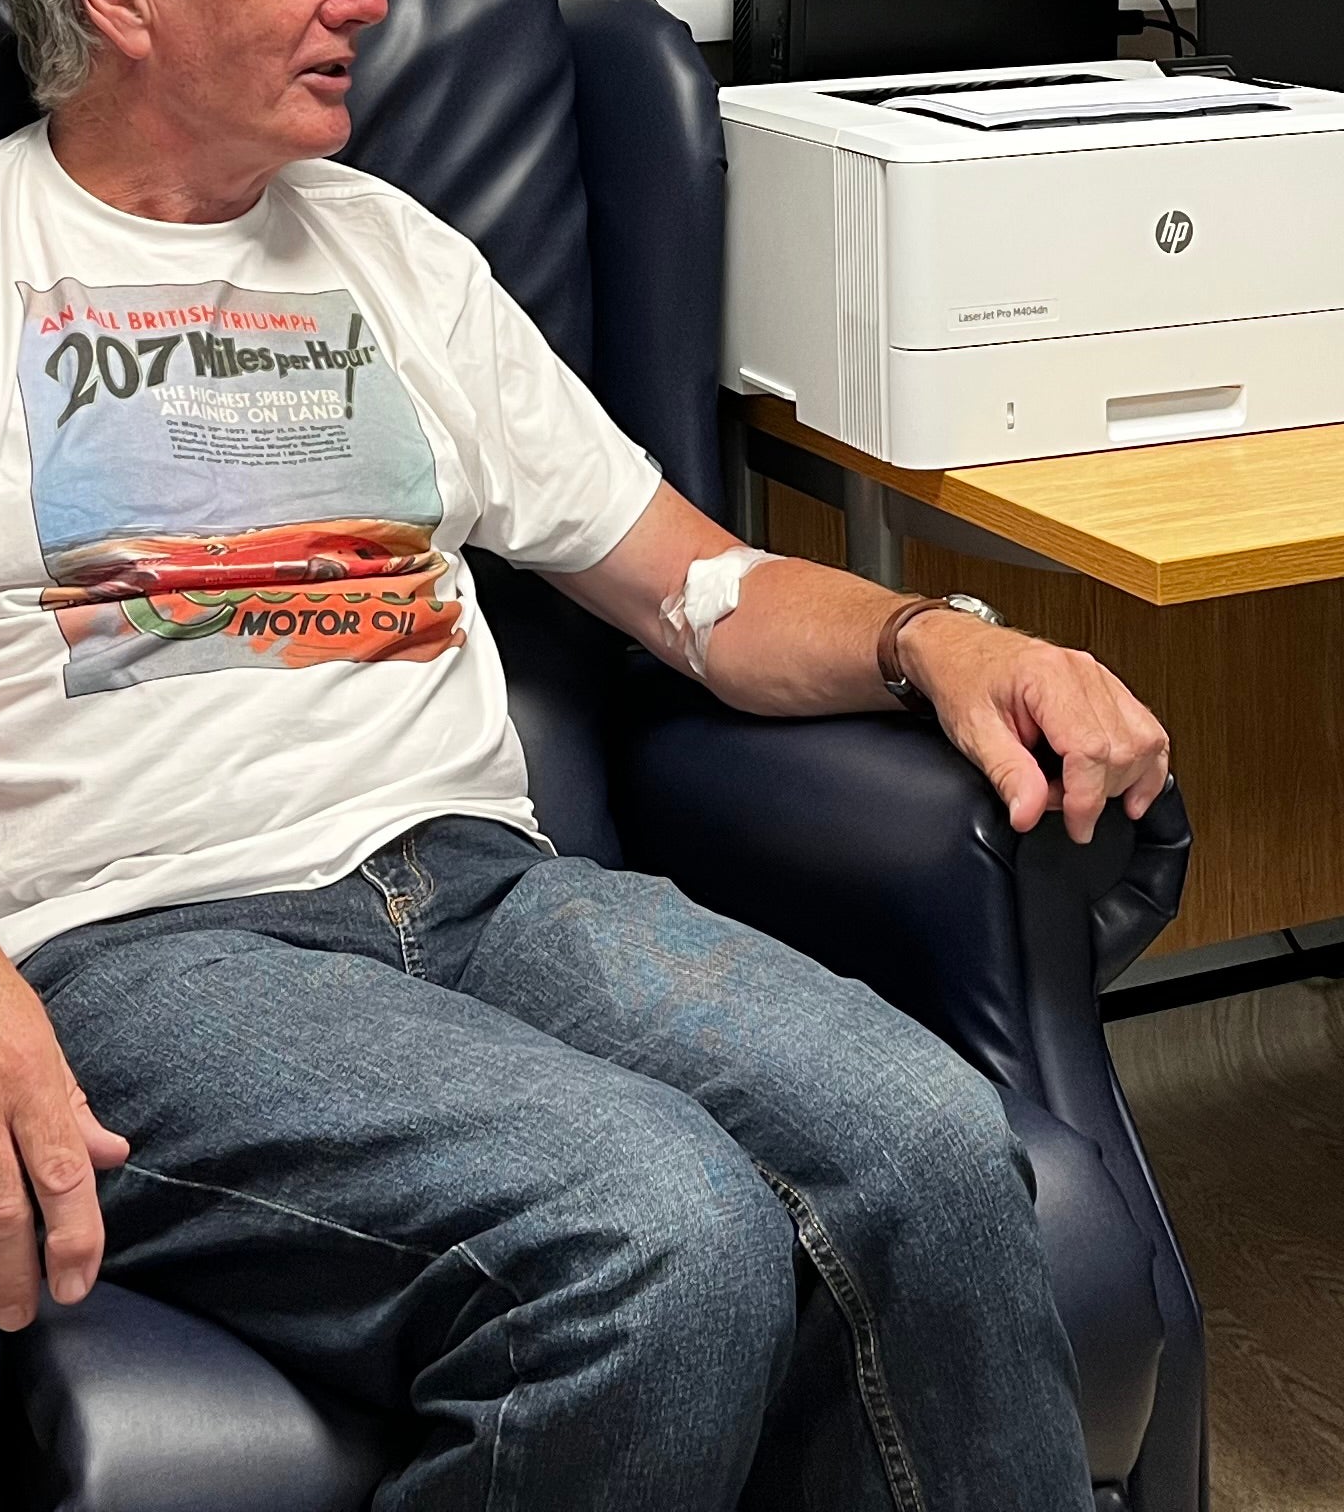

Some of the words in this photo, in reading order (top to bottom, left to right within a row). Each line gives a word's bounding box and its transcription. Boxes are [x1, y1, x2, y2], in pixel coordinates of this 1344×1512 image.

[1157, 210, 1192, 254] hp
[40, 304, 75, 335] AN
[86, 305, 121, 331] ALL
[127, 304, 217, 331] BRITISH
[219, 310, 318, 334] TRIUMPH
[996, 308, 1012, 319] Pro
[44, 331, 183, 429] 207
[186, 330, 276, 379] Miles
[273, 351, 311, 379] per
[151, 384, 185, 401] THE
[255, 390, 298, 407] SPEED
[299, 389, 342, 405] EVER
[159, 400, 241, 424] ATTAINED
[247, 407, 279, 423] ON
[288, 404, 345, 422] LAND
[238, 608, 362, 637] MOTOR
[371, 610, 416, 636] OIL
